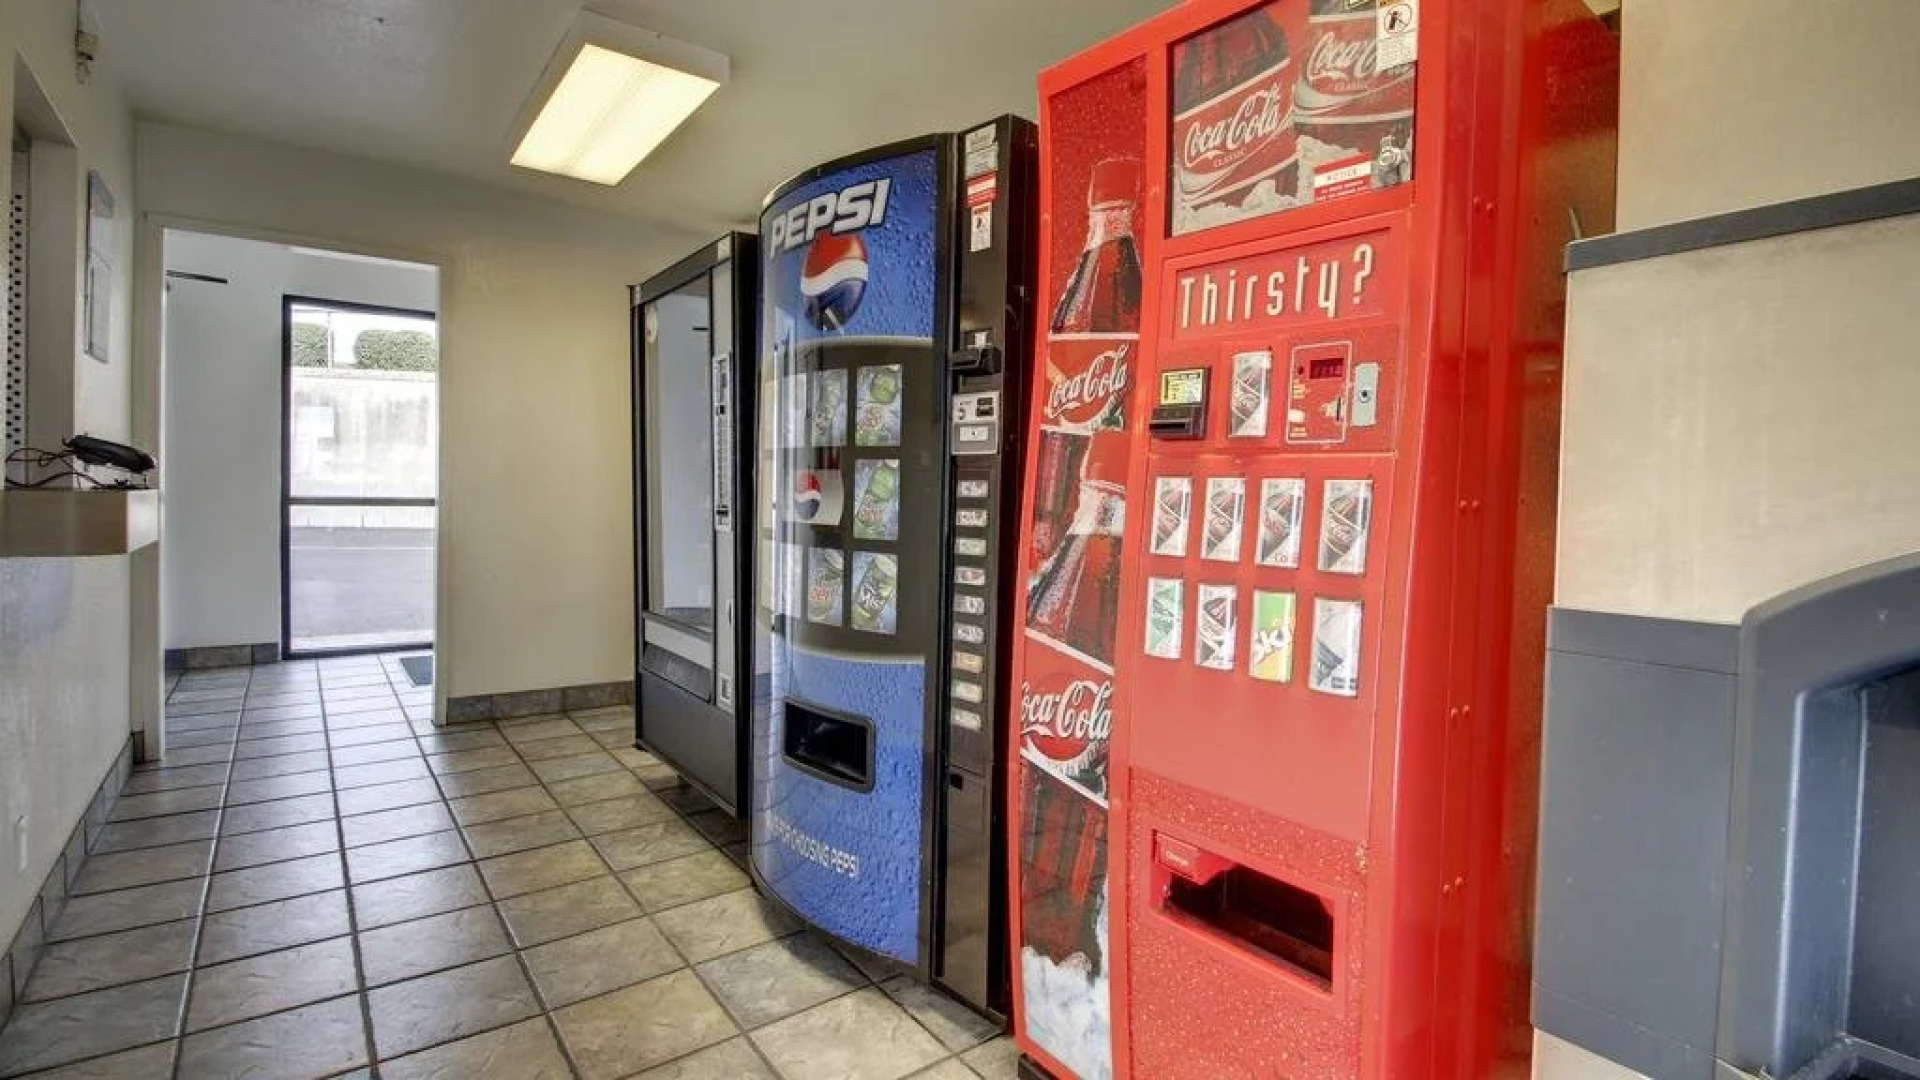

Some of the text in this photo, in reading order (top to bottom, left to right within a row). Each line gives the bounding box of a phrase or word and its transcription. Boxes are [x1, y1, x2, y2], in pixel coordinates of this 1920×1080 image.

[1185, 82, 1282, 168] Coca-Cola
[770, 177, 893, 260] PEPSI
[1180, 243, 1374, 329] Thirsty?
[1046, 342, 1129, 419] Coca-Cola
[1020, 680, 1113, 738] oca-Cola
[830, 847, 861, 881] PEPSI
